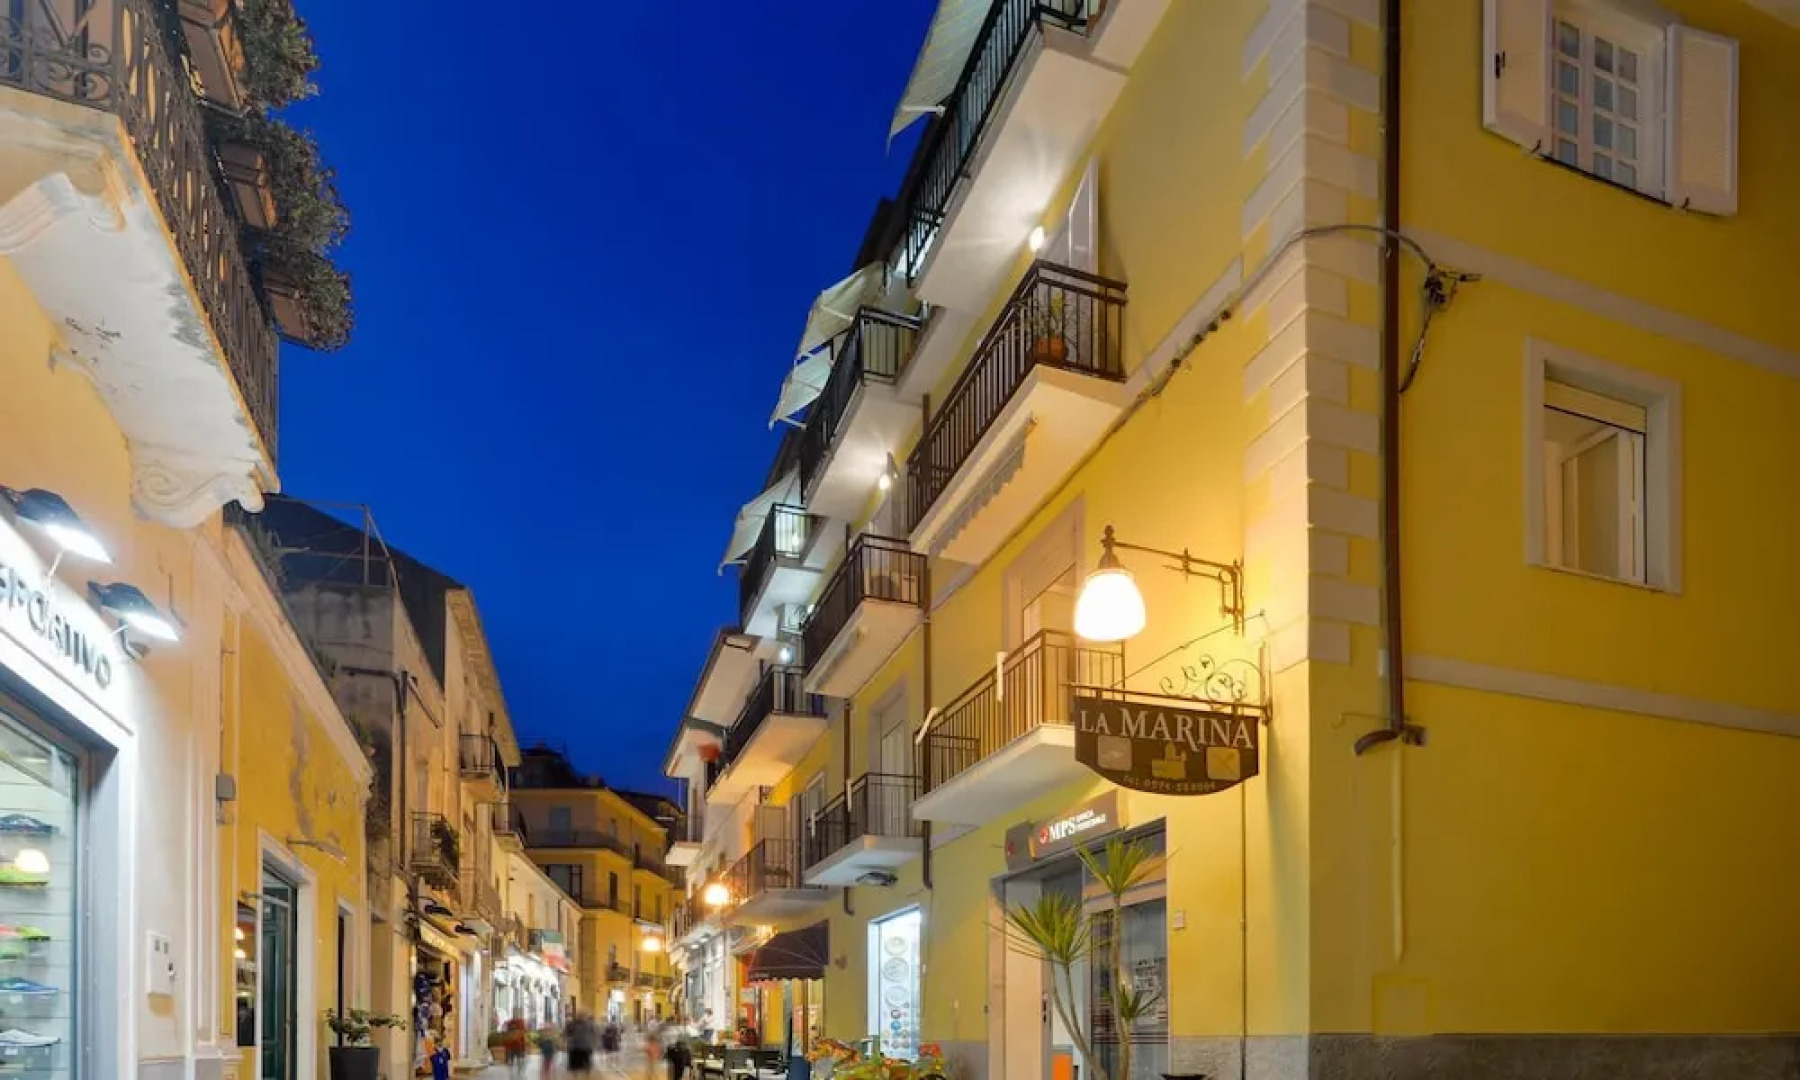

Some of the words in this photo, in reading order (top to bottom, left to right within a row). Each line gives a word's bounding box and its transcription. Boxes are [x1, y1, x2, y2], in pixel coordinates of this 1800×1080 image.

[1079, 710, 1112, 735] LA
[1120, 707, 1254, 753] MARINA
[1048, 816, 1076, 843] MPS
